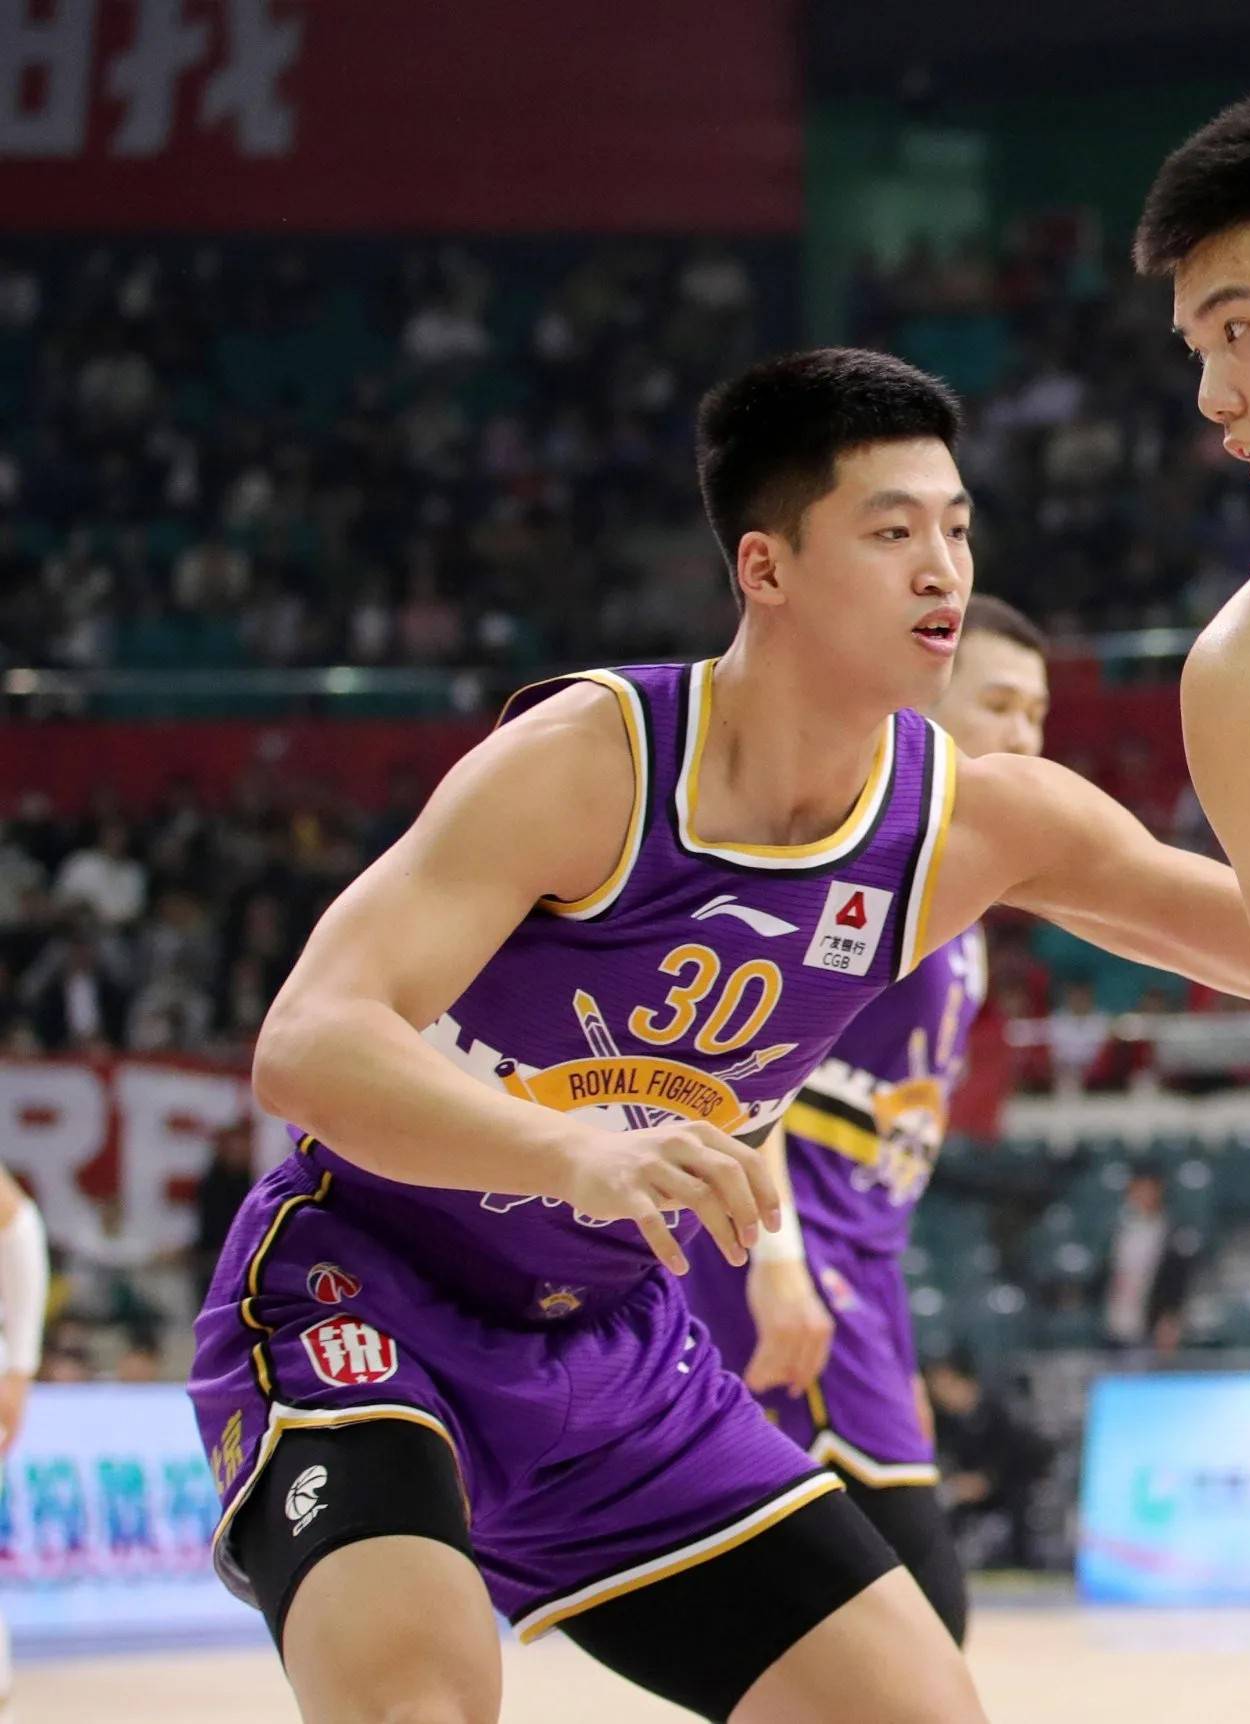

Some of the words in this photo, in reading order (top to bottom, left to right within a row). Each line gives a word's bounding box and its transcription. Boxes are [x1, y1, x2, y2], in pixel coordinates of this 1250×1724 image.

[822, 952, 851, 970] CGB
[628, 943, 783, 1055] 30
[568, 1067, 639, 1101] ROYAL
[646, 1069, 724, 1117] FIGHTERS
